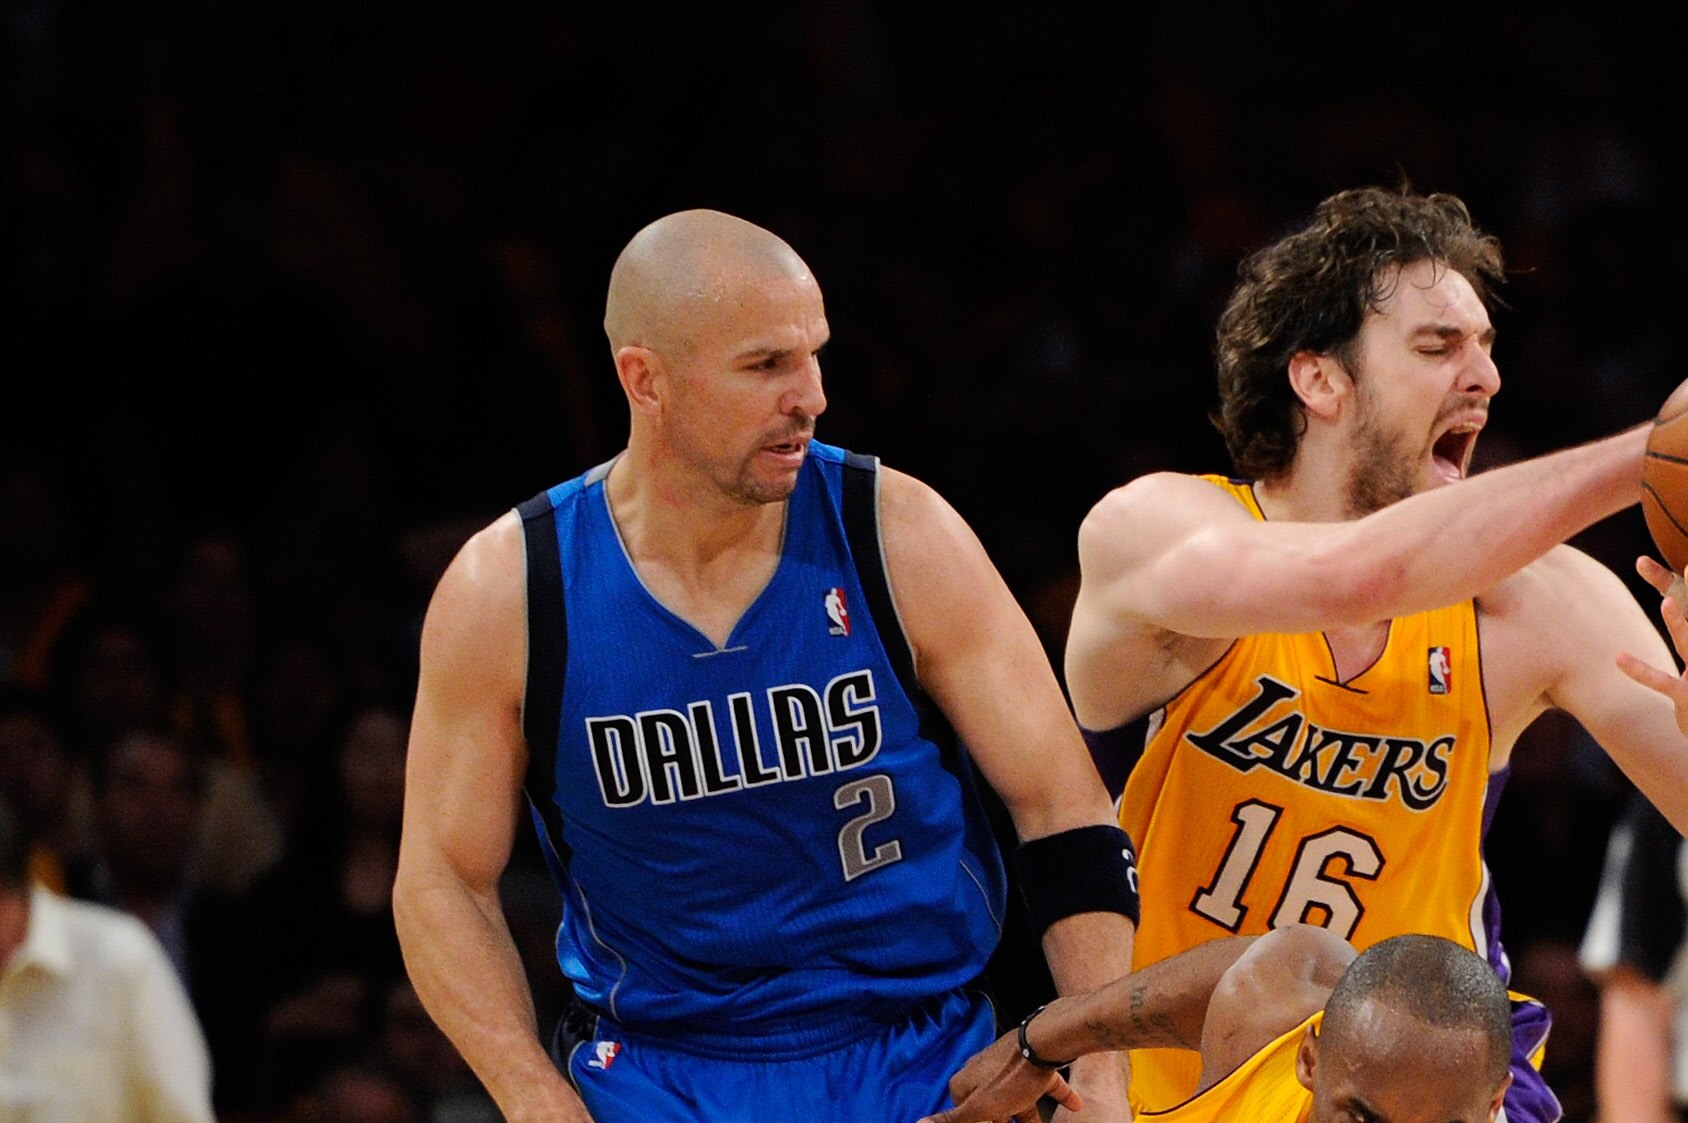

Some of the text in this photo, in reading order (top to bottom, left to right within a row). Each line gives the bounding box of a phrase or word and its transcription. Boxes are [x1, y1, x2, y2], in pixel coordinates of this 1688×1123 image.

[586, 669, 882, 809] DALLAS
[1186, 673, 1456, 813] LAKERS
[833, 774, 902, 883] 2
[1189, 798, 1386, 941] 16
